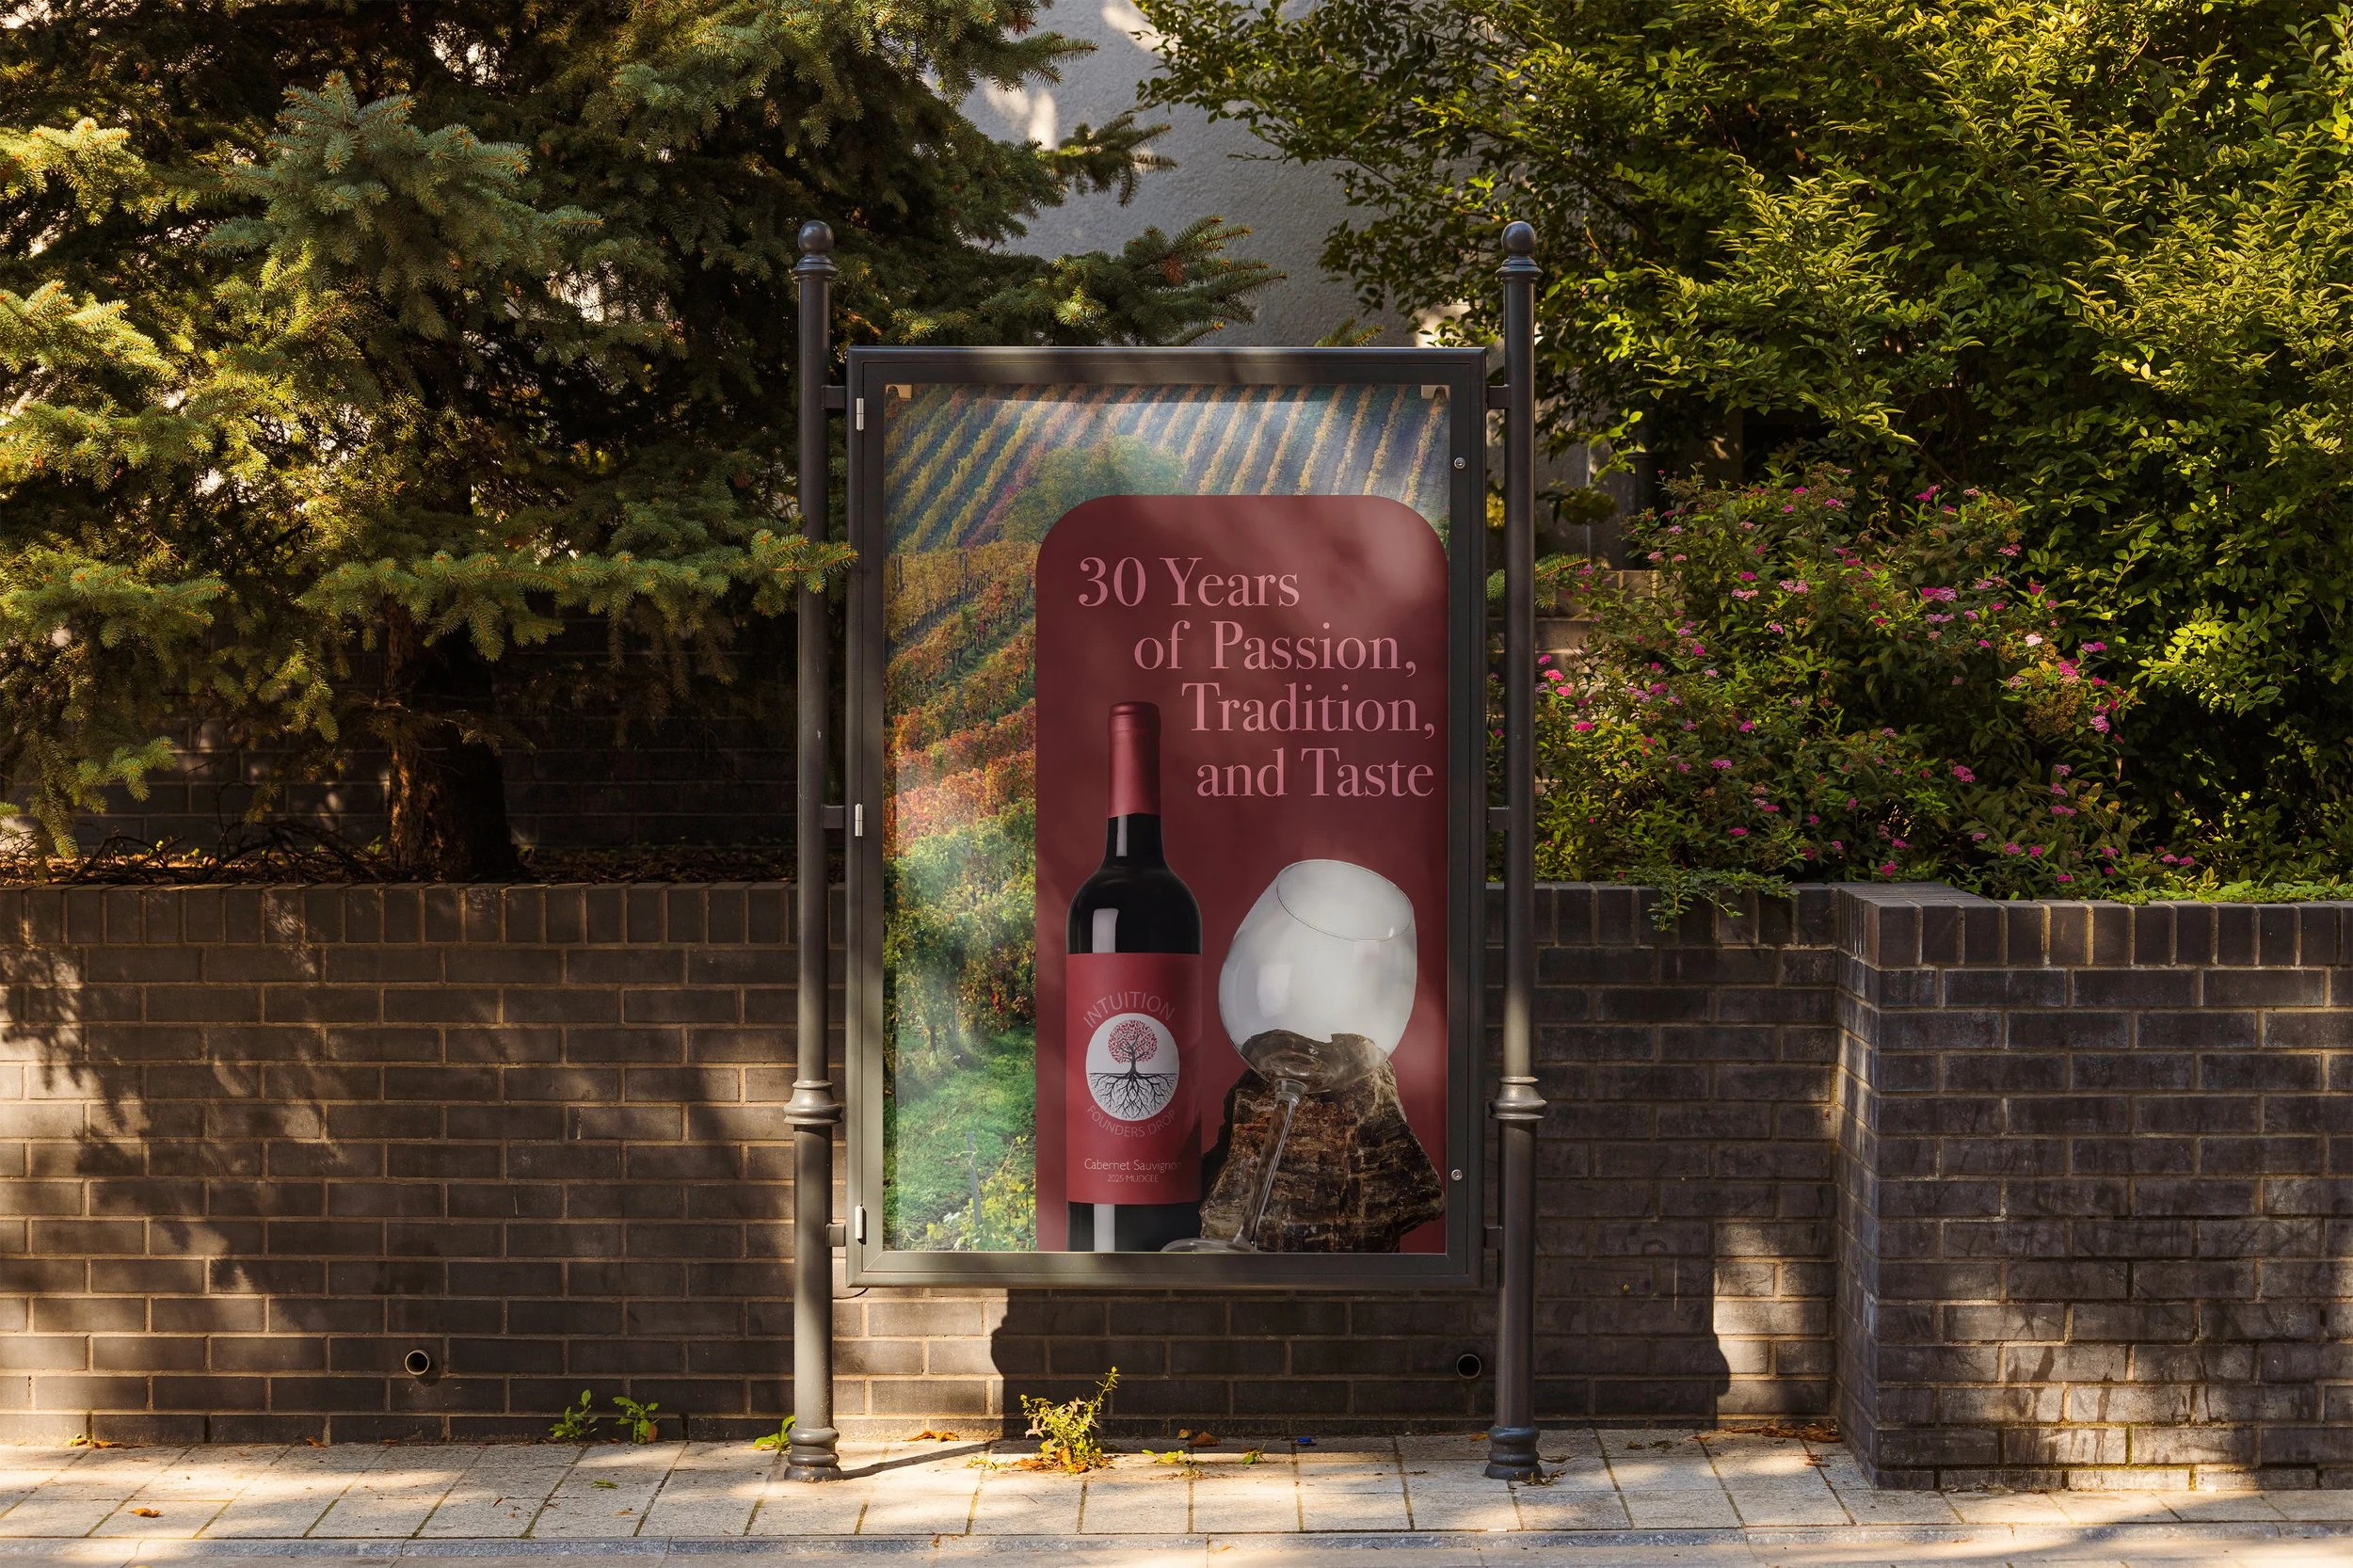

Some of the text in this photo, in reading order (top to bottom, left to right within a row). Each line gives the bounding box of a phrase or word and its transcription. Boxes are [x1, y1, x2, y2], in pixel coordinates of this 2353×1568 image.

[1078, 556, 1300, 607] 30 Years
[1133, 619, 1417, 678] of Passion,
[1181, 682, 1435, 740] Tradition,
[1195, 747, 1434, 797] and Taste
[1083, 991, 1176, 1029] INTUITION
[1086, 1105, 1176, 1138] FOUNDERS DROP
[1083, 1158, 1131, 1171] Cabernet
[1107, 1174, 1125, 1183] 2025
